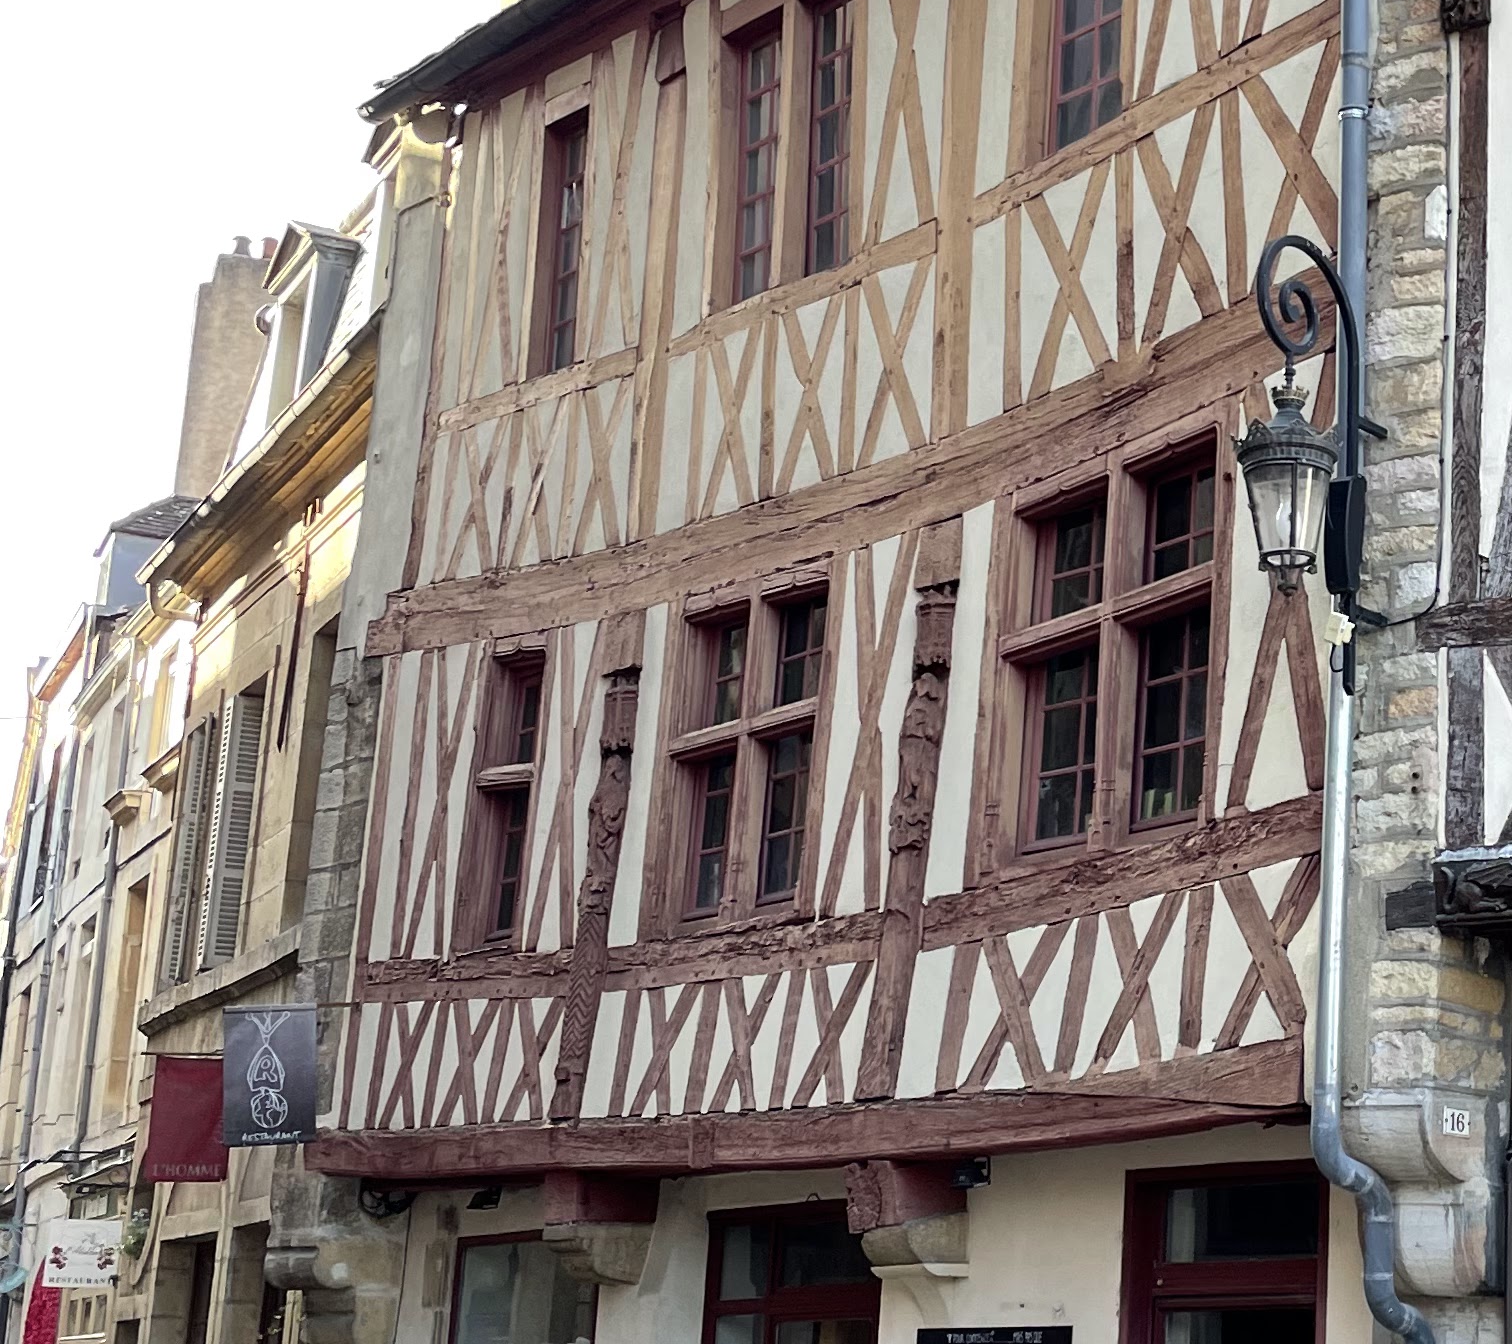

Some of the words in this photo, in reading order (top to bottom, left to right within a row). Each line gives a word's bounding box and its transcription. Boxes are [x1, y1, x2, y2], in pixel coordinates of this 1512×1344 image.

[1450, 1112, 1465, 1133] 16
[240, 1130, 301, 1143] RESTAURANT
[152, 1163, 222, 1178] L'HOMME
